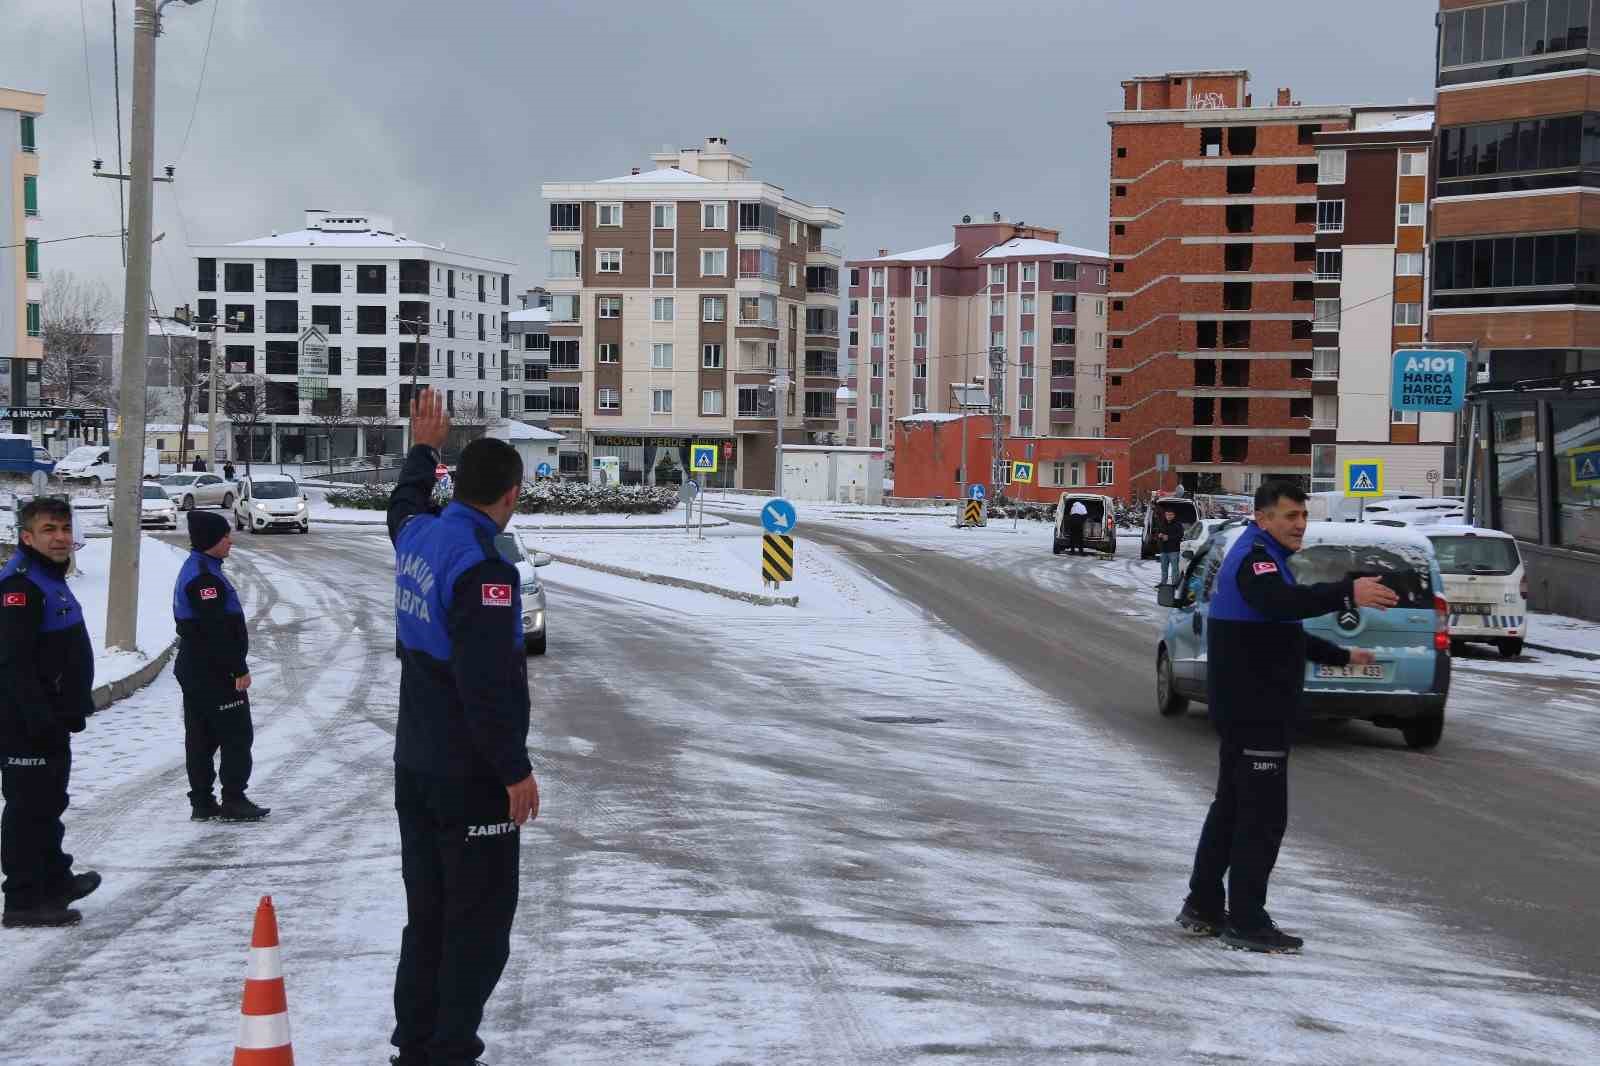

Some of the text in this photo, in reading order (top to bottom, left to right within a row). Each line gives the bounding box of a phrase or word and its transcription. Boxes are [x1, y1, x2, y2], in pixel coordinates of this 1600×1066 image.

[1403, 373, 1453, 383] HARCA
[1403, 384, 1453, 394] HARCA
[7, 756, 47, 766] ZABITA
[467, 822, 517, 836] ZABITA
